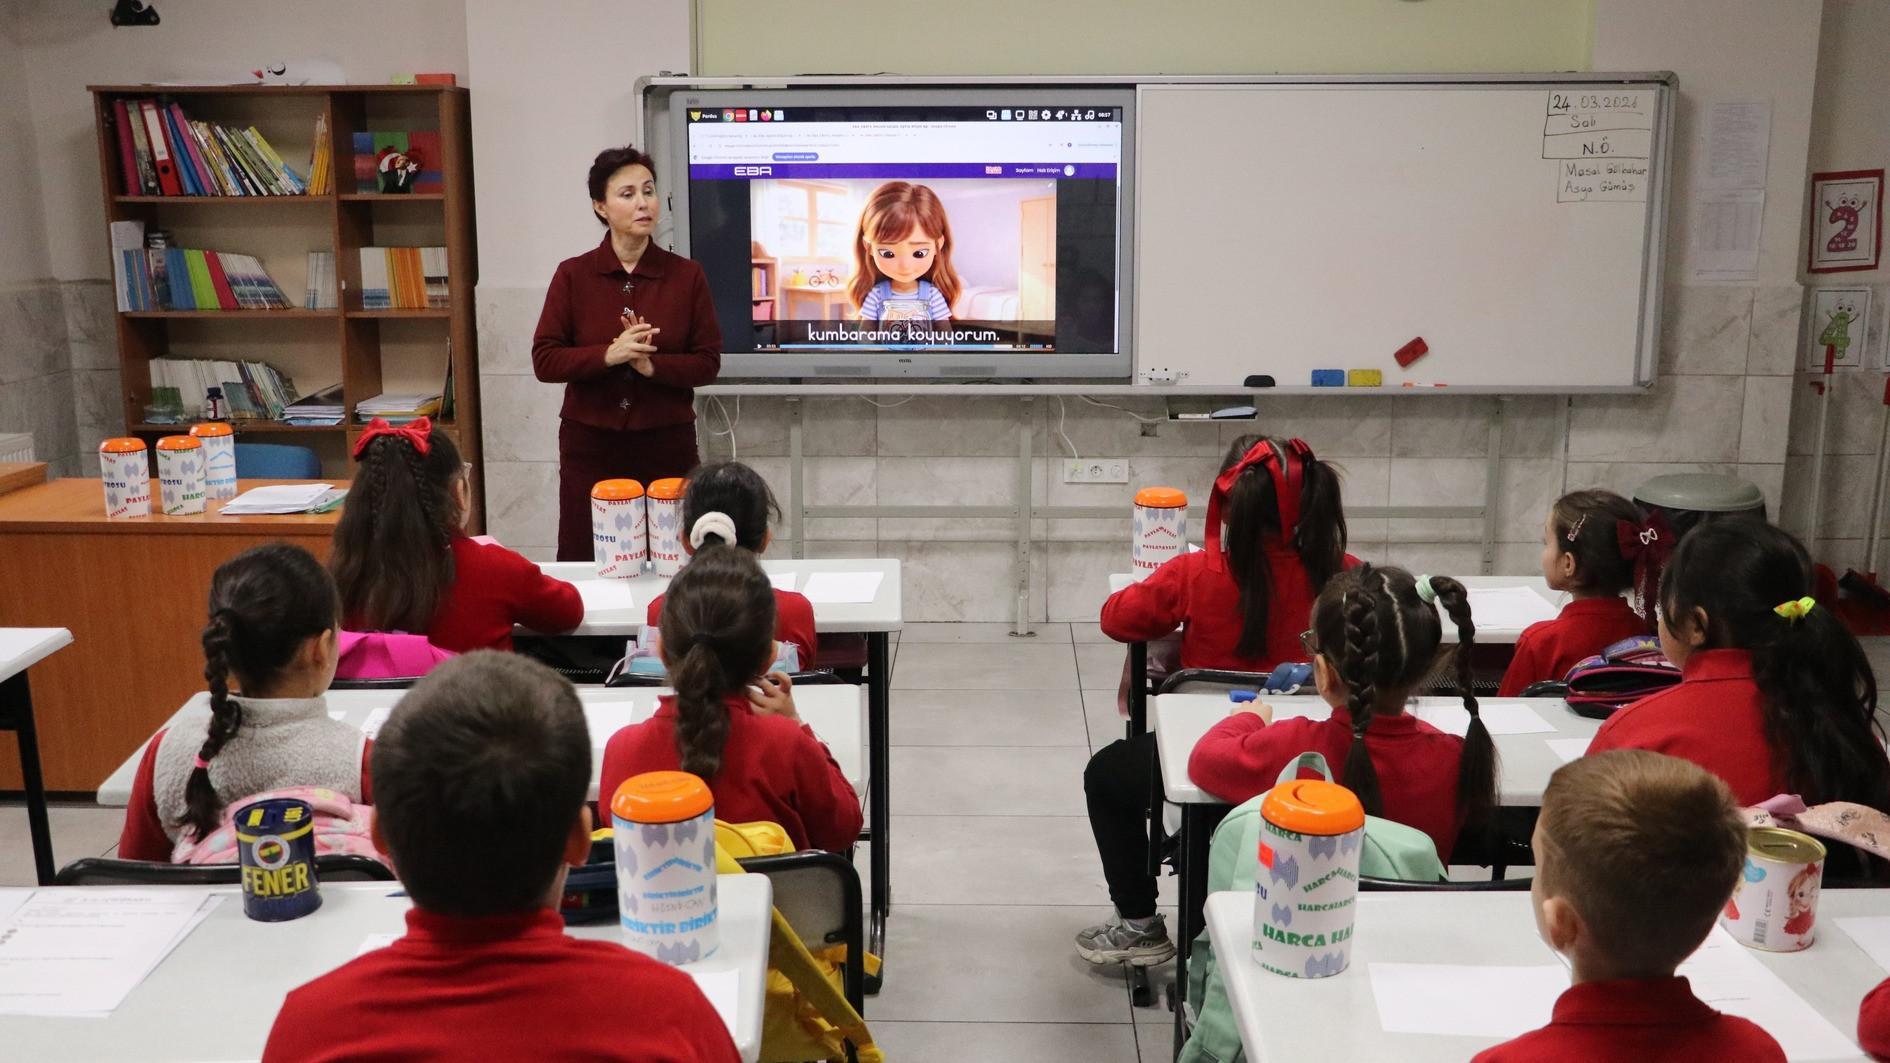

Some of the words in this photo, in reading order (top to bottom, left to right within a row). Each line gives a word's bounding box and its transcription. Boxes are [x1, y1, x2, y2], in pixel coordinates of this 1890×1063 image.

[734, 166, 772, 176] EBA
[1827, 206, 1858, 252] 2
[808, 323, 900, 341] kumbarama
[908, 323, 1000, 346] koyuyorum.
[1818, 311, 1851, 359] 4
[242, 863, 310, 897] FENER
[1262, 922, 1327, 948] HARCA
